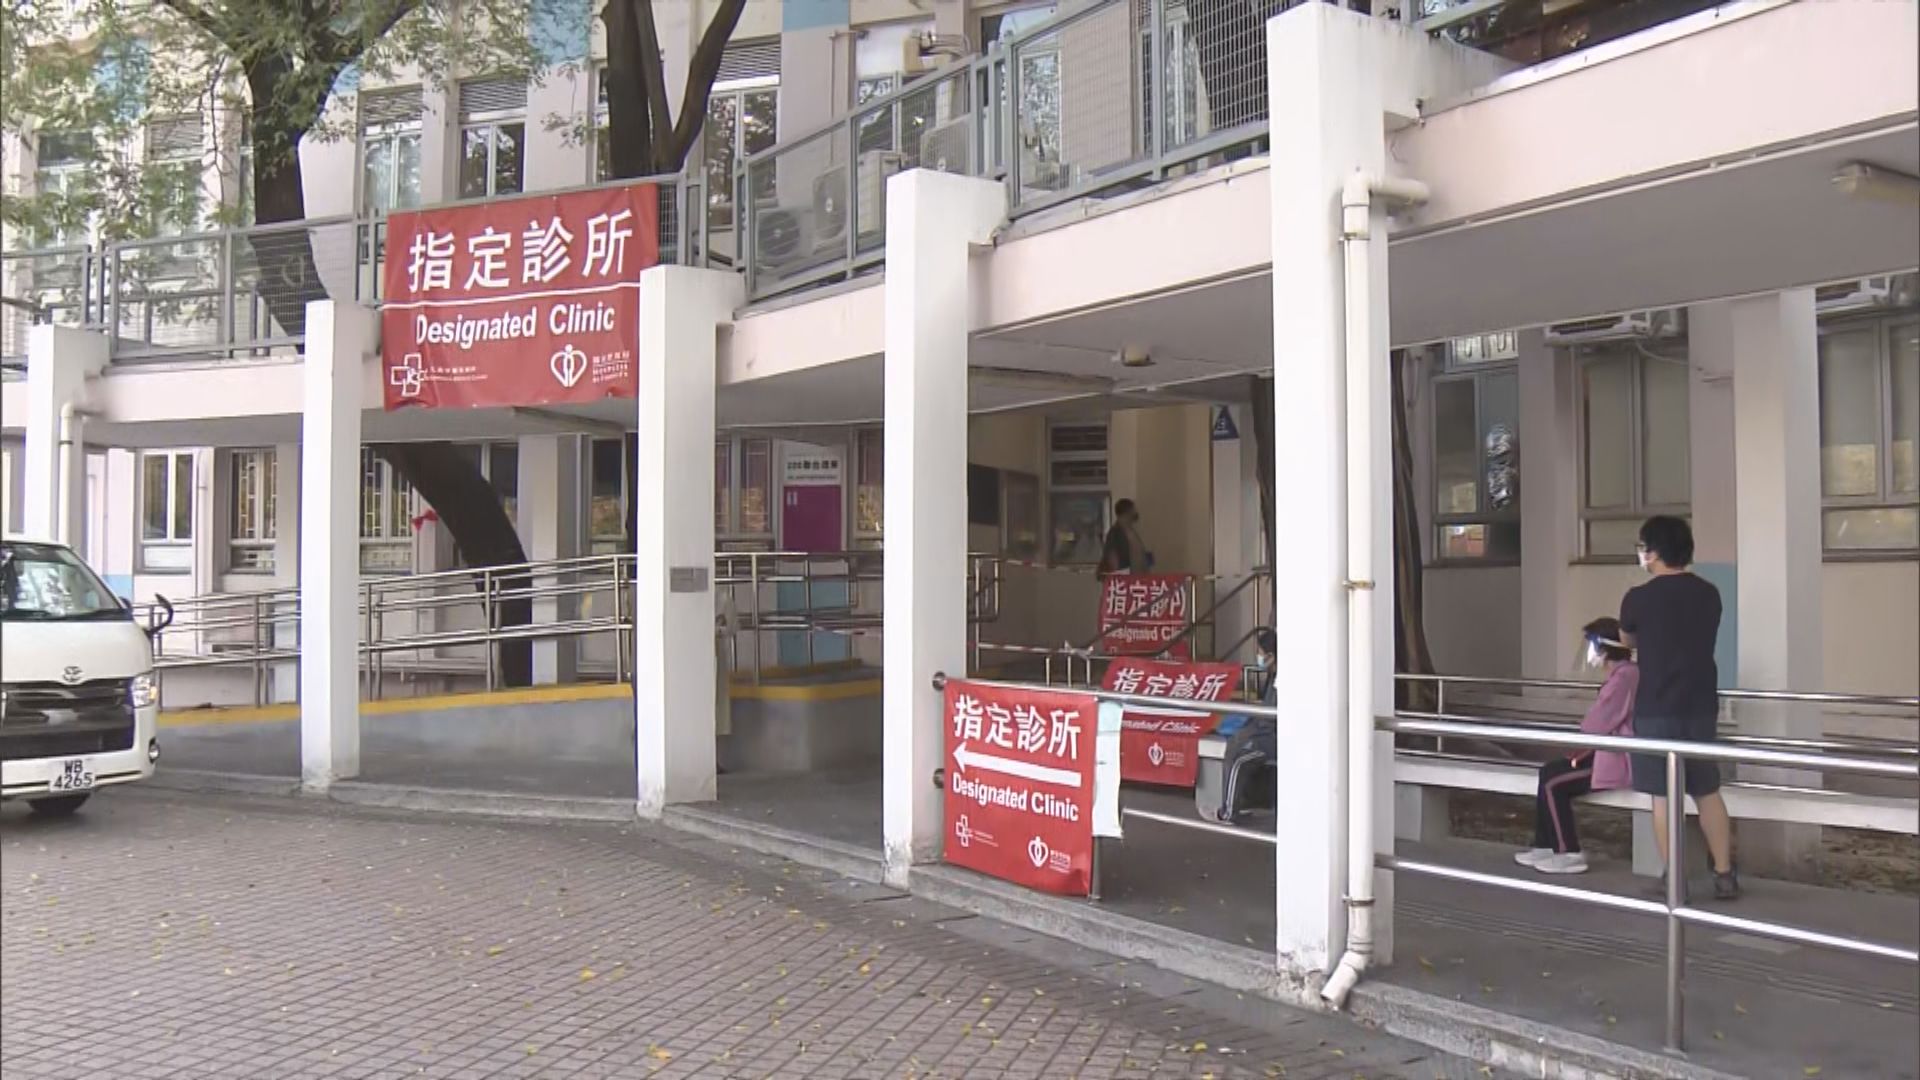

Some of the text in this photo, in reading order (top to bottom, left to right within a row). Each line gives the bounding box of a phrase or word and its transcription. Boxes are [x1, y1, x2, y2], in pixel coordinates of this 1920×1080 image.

[408, 208, 632, 293] 指定診所
[416, 301, 615, 349] Designated Clinic
[1113, 667, 1228, 701] 指定診所
[953, 694, 1081, 760] 指定診所
[54, 772, 93, 789] 4265
[64, 759, 83, 773] WB
[952, 772, 1079, 822] Designated Clinic
